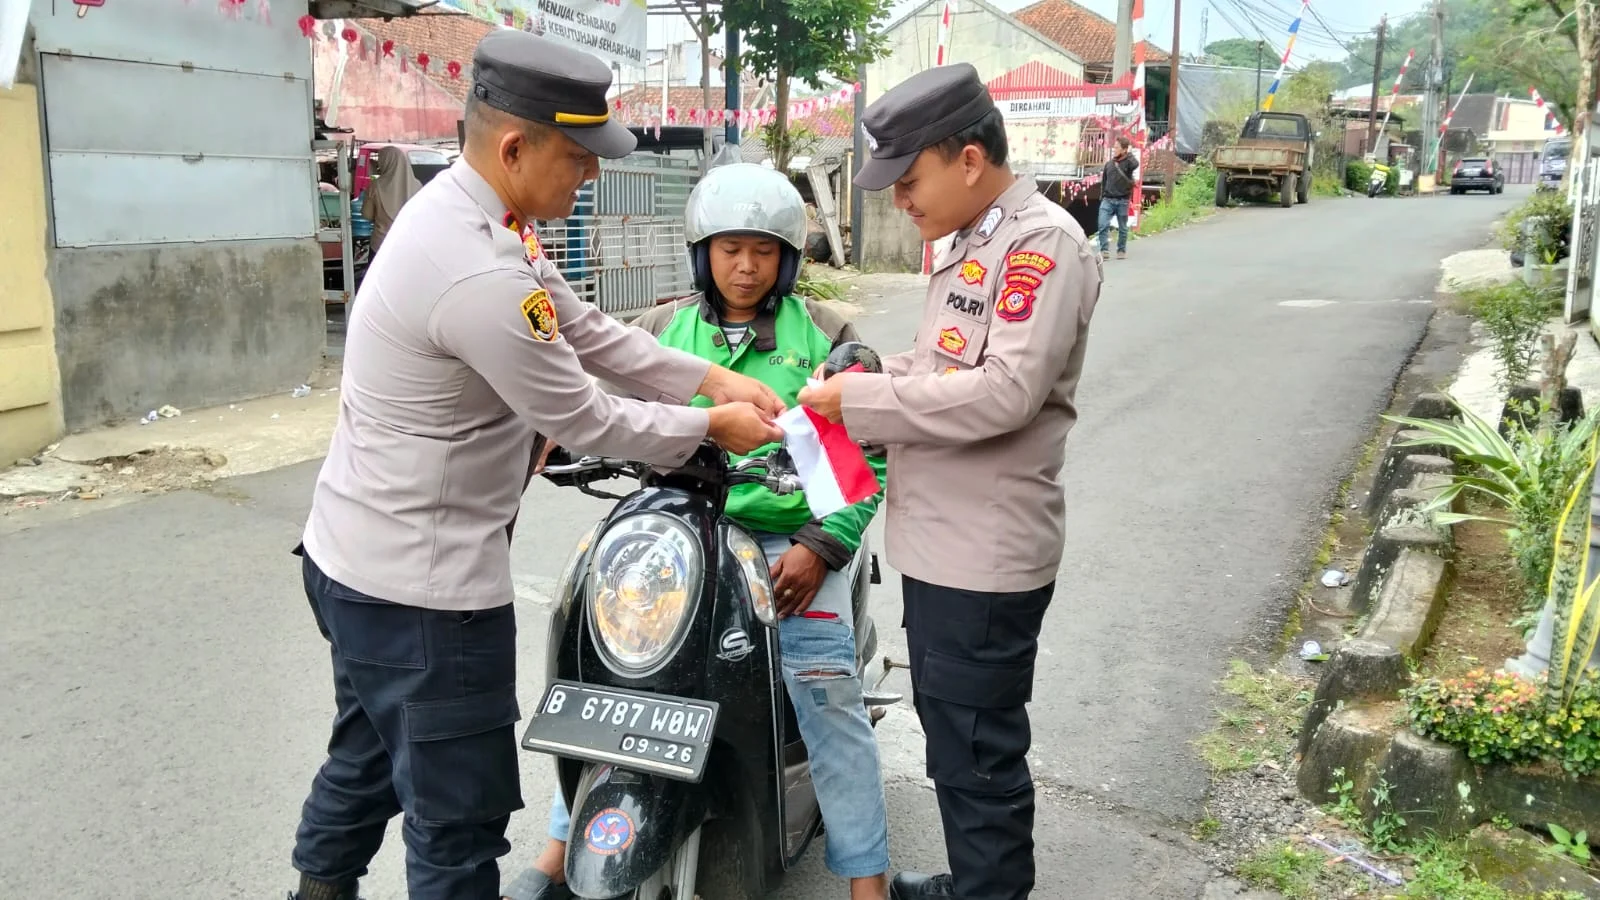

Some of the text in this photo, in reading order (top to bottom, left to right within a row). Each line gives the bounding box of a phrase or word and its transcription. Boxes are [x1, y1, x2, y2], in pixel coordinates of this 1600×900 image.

[538, 0, 617, 34] MENJUAL SEMBAKO
[548, 20, 598, 46] KEBUTUHAN
[599, 37, 641, 62] SEHARI-HARI
[1009, 253, 1052, 268] POLRES
[946, 291, 985, 317] POLRI
[769, 355, 784, 366] GO
[547, 690, 567, 714] B
[581, 697, 645, 729] 6787
